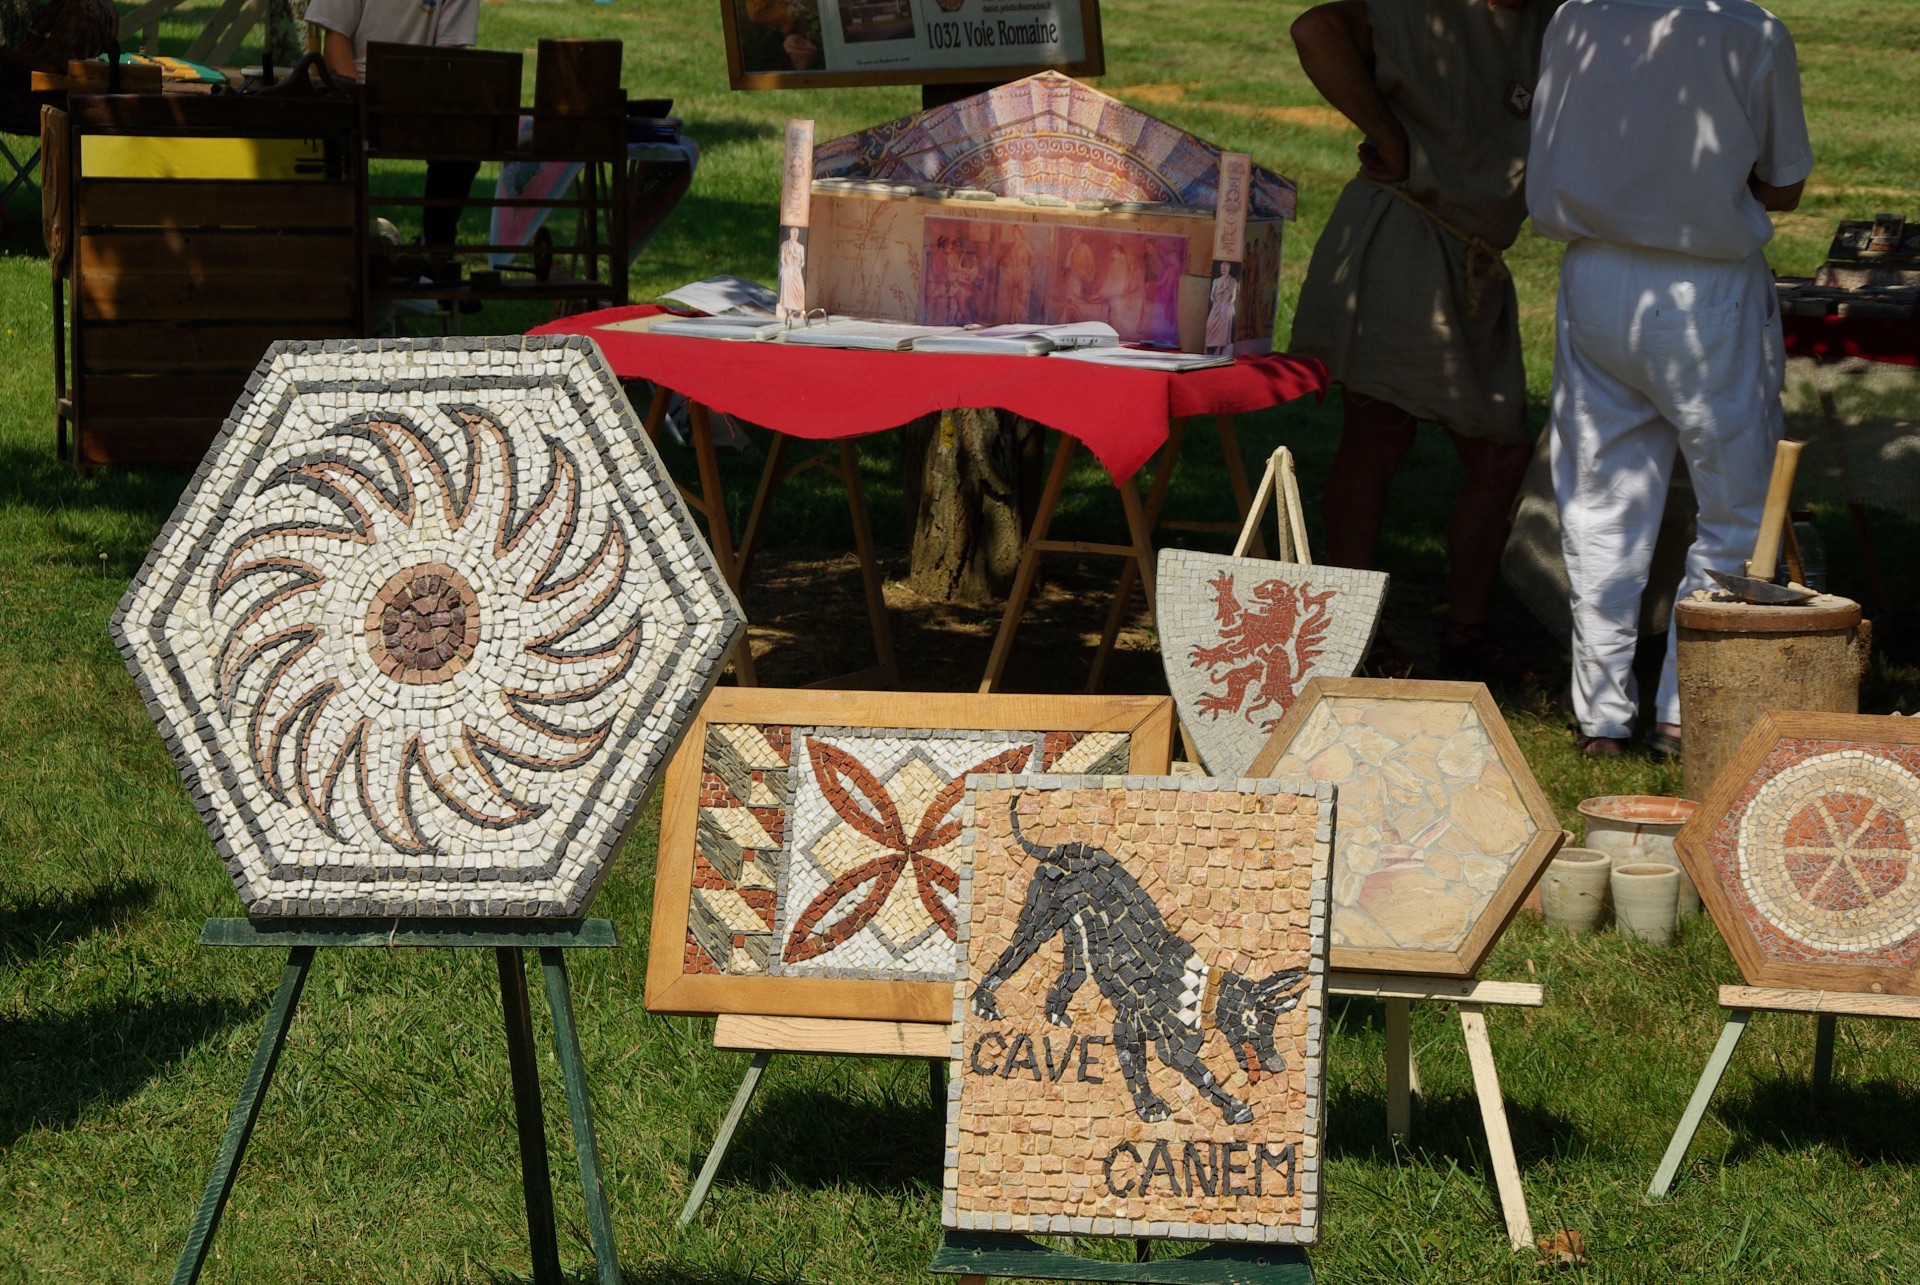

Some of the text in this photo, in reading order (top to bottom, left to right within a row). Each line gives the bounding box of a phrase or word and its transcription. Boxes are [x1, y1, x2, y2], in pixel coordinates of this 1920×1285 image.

[927, 17, 1058, 49] 1032 Voie Romaine
[971, 1031, 1106, 1084] CAVE
[1103, 1139, 1296, 1198] CANEM
